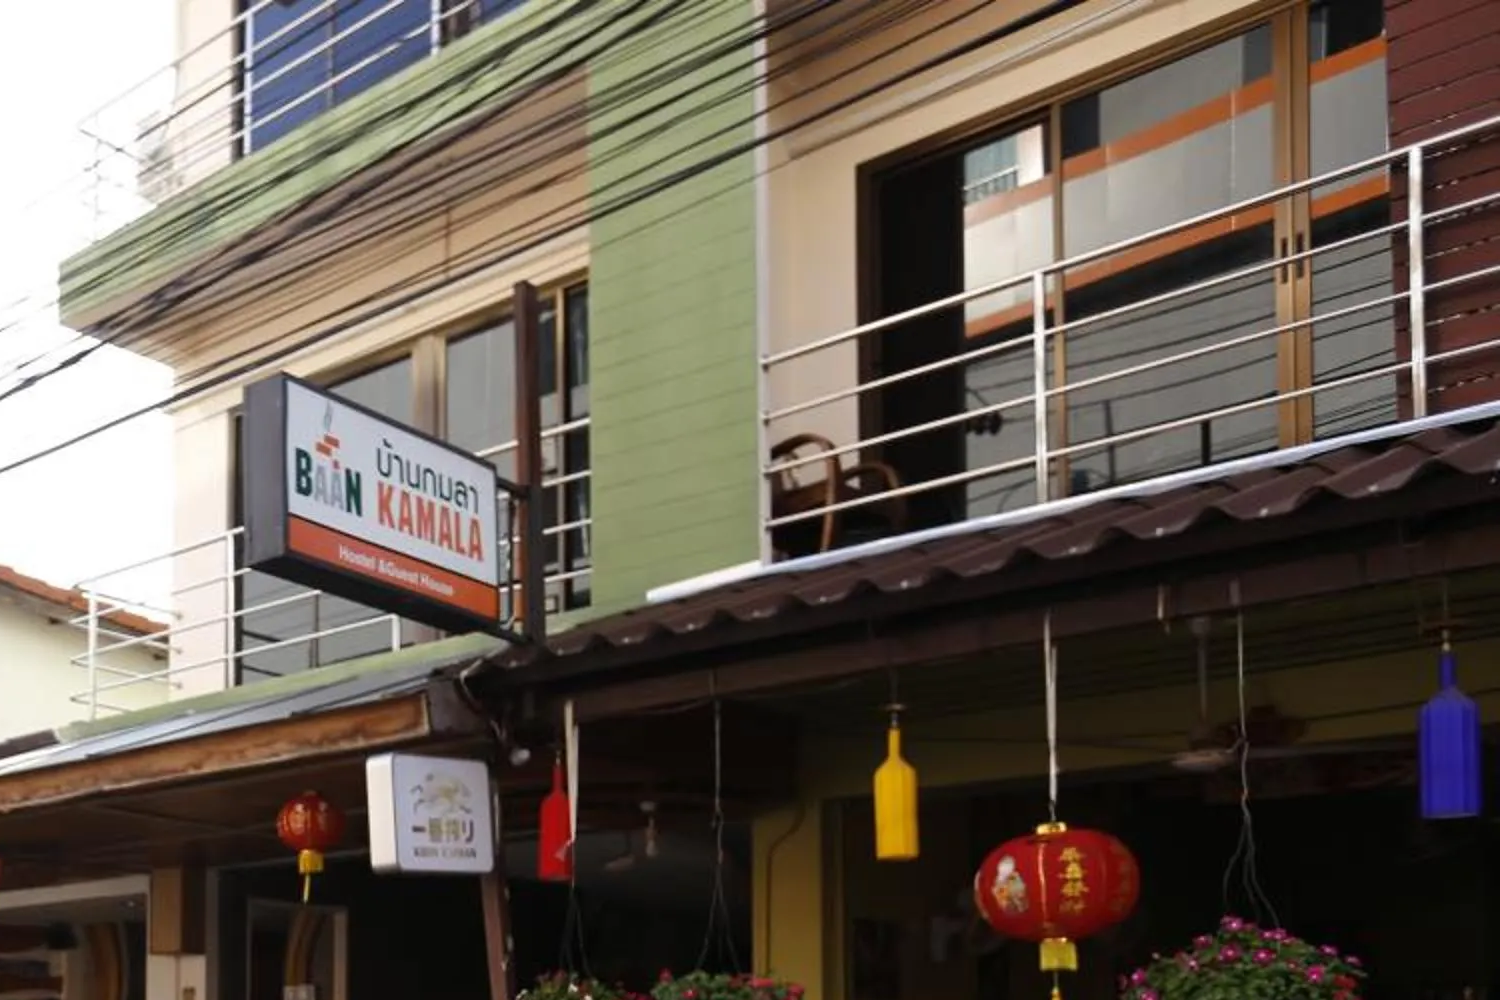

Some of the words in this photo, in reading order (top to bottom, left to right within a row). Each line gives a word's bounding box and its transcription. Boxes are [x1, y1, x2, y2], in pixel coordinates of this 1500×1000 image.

[377, 438, 479, 515] บ้านกมลา
[377, 479, 484, 562] KAMALA
